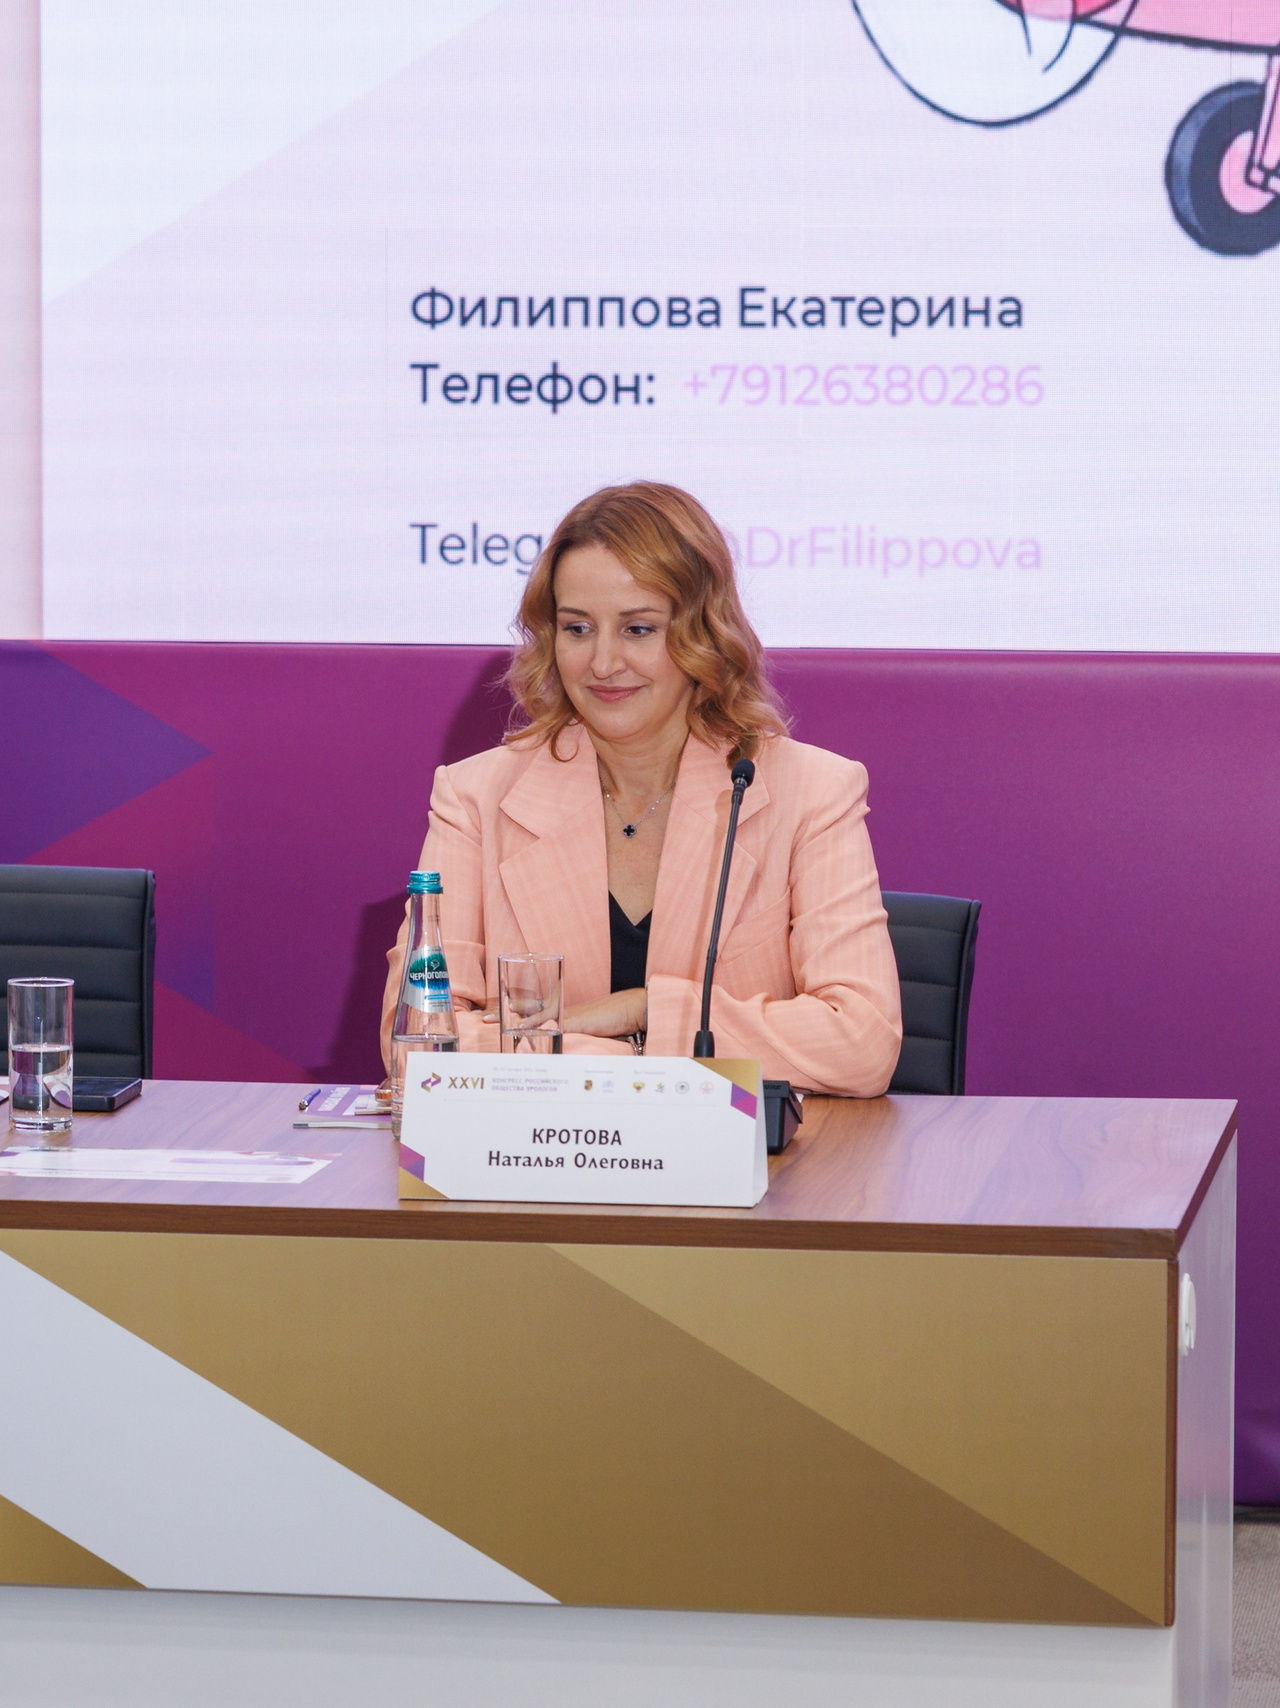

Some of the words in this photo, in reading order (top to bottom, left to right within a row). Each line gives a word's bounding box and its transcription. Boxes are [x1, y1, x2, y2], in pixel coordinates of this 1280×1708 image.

[411, 287, 721, 329] Филиппова
[739, 287, 1023, 337] Екатерина
[410, 361, 655, 414] Телефон:
[683, 363, 1045, 406] +79126380286
[409, 522, 543, 575] Teleg
[448, 1076, 485, 1090] XXVI
[532, 1128, 622, 1146] КРОТОВА
[488, 1150, 564, 1168] Наталья
[574, 1152, 664, 1170] Олеговна
